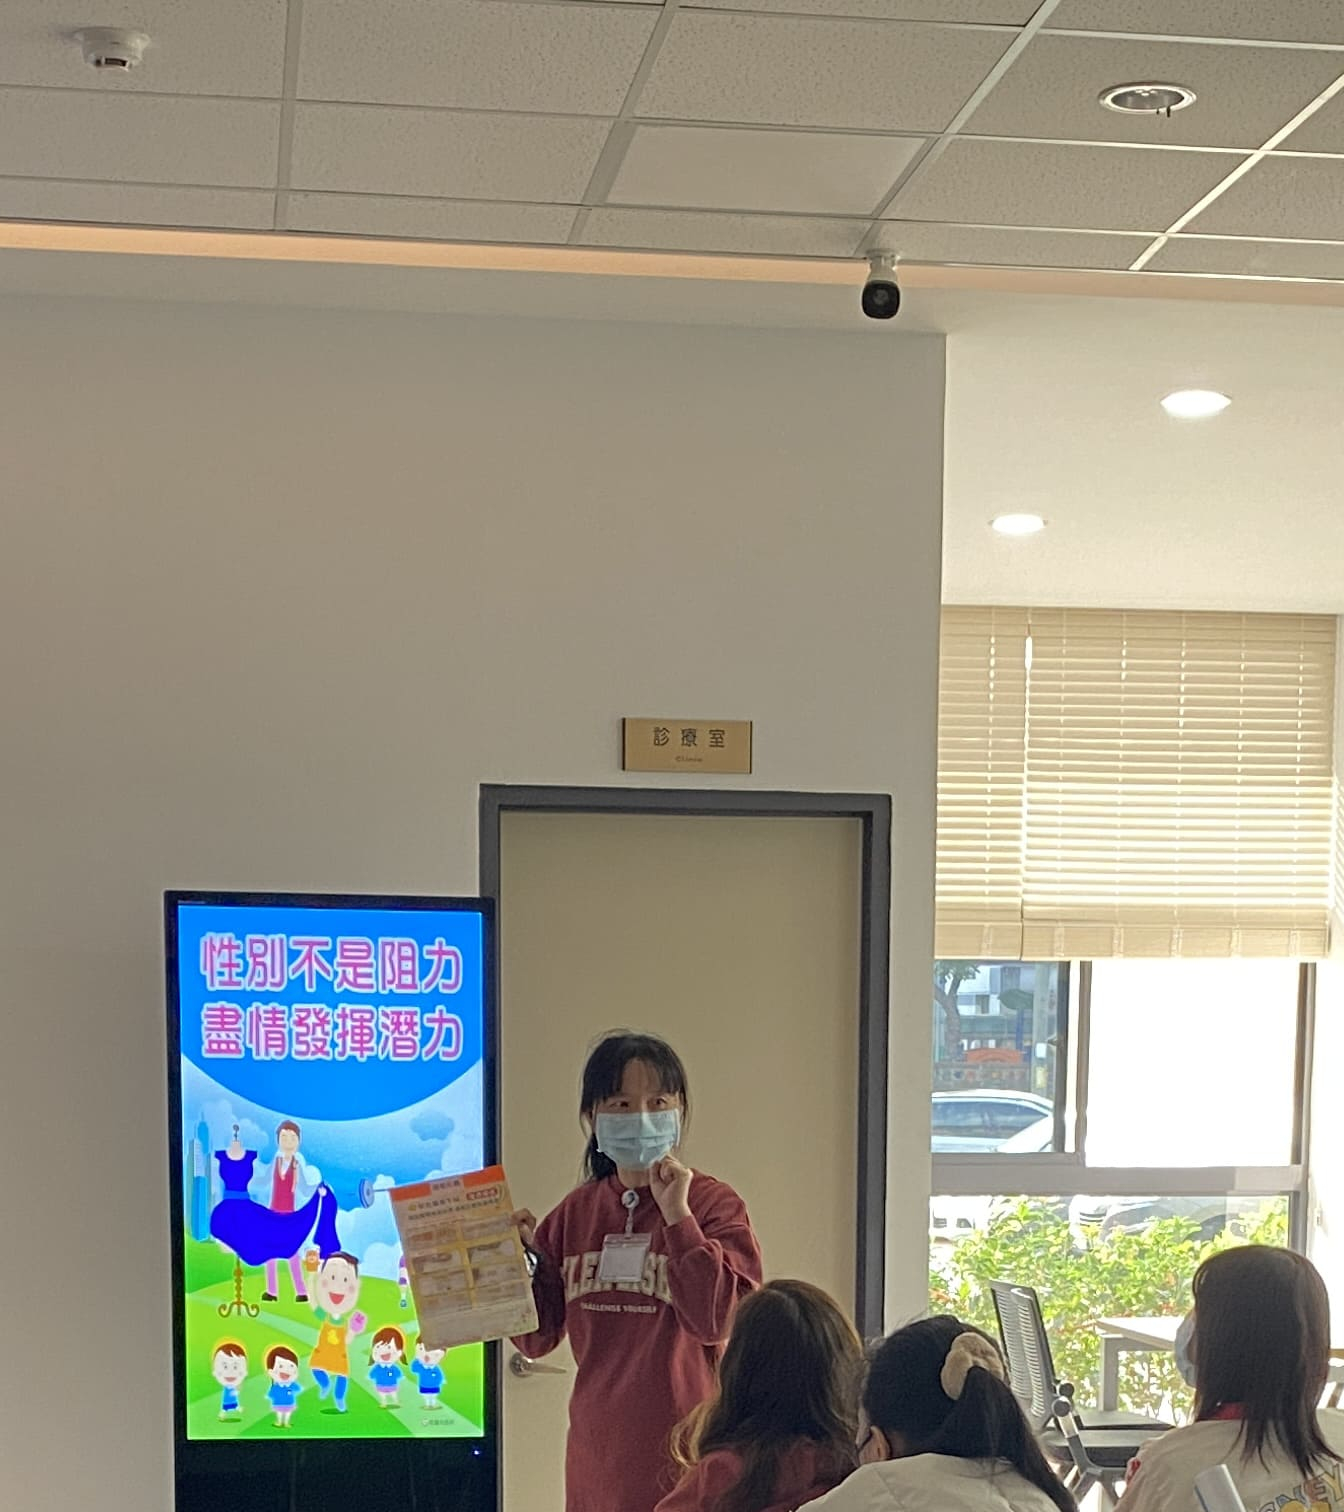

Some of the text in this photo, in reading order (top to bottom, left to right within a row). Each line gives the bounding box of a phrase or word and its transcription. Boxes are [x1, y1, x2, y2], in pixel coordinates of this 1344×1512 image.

[653, 726, 725, 748] 診療室
[200, 932, 464, 994] 性別不是阻力
[200, 1003, 464, 1062] 盡情發揮潛力
